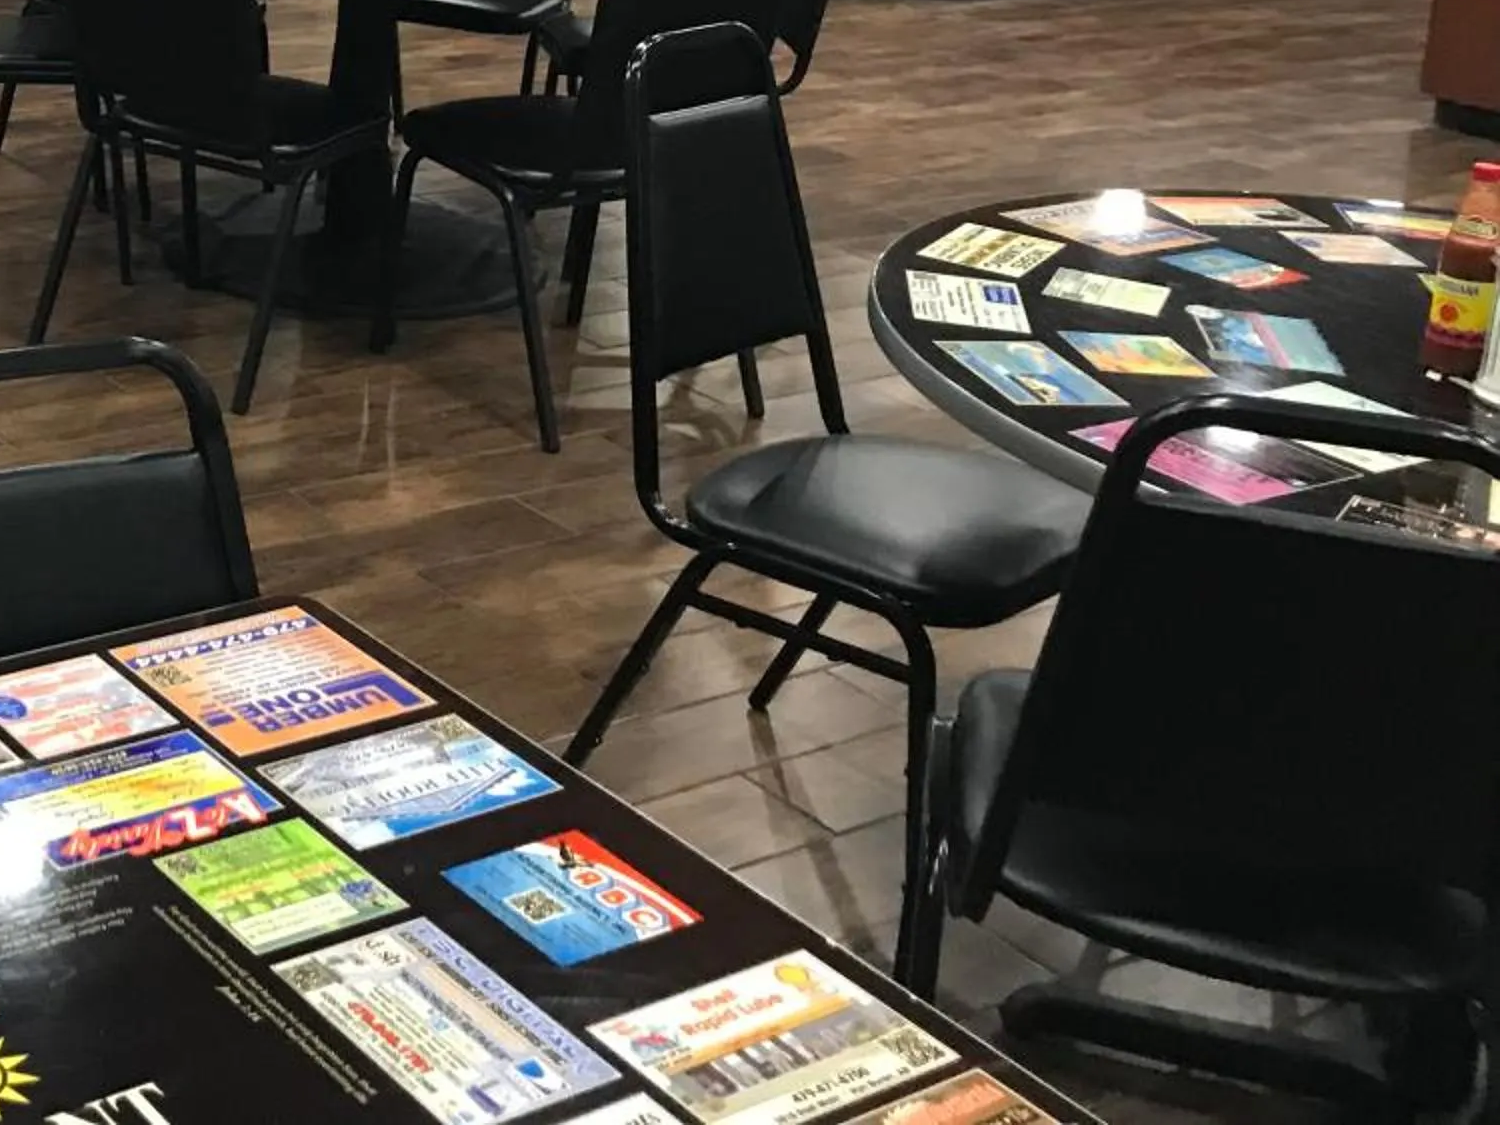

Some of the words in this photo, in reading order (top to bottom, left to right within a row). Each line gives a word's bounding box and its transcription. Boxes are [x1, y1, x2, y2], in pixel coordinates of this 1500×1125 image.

[230, 686, 325, 719] ONE
[676, 1008, 742, 1037] Rapid
[733, 991, 787, 1015] Lube
